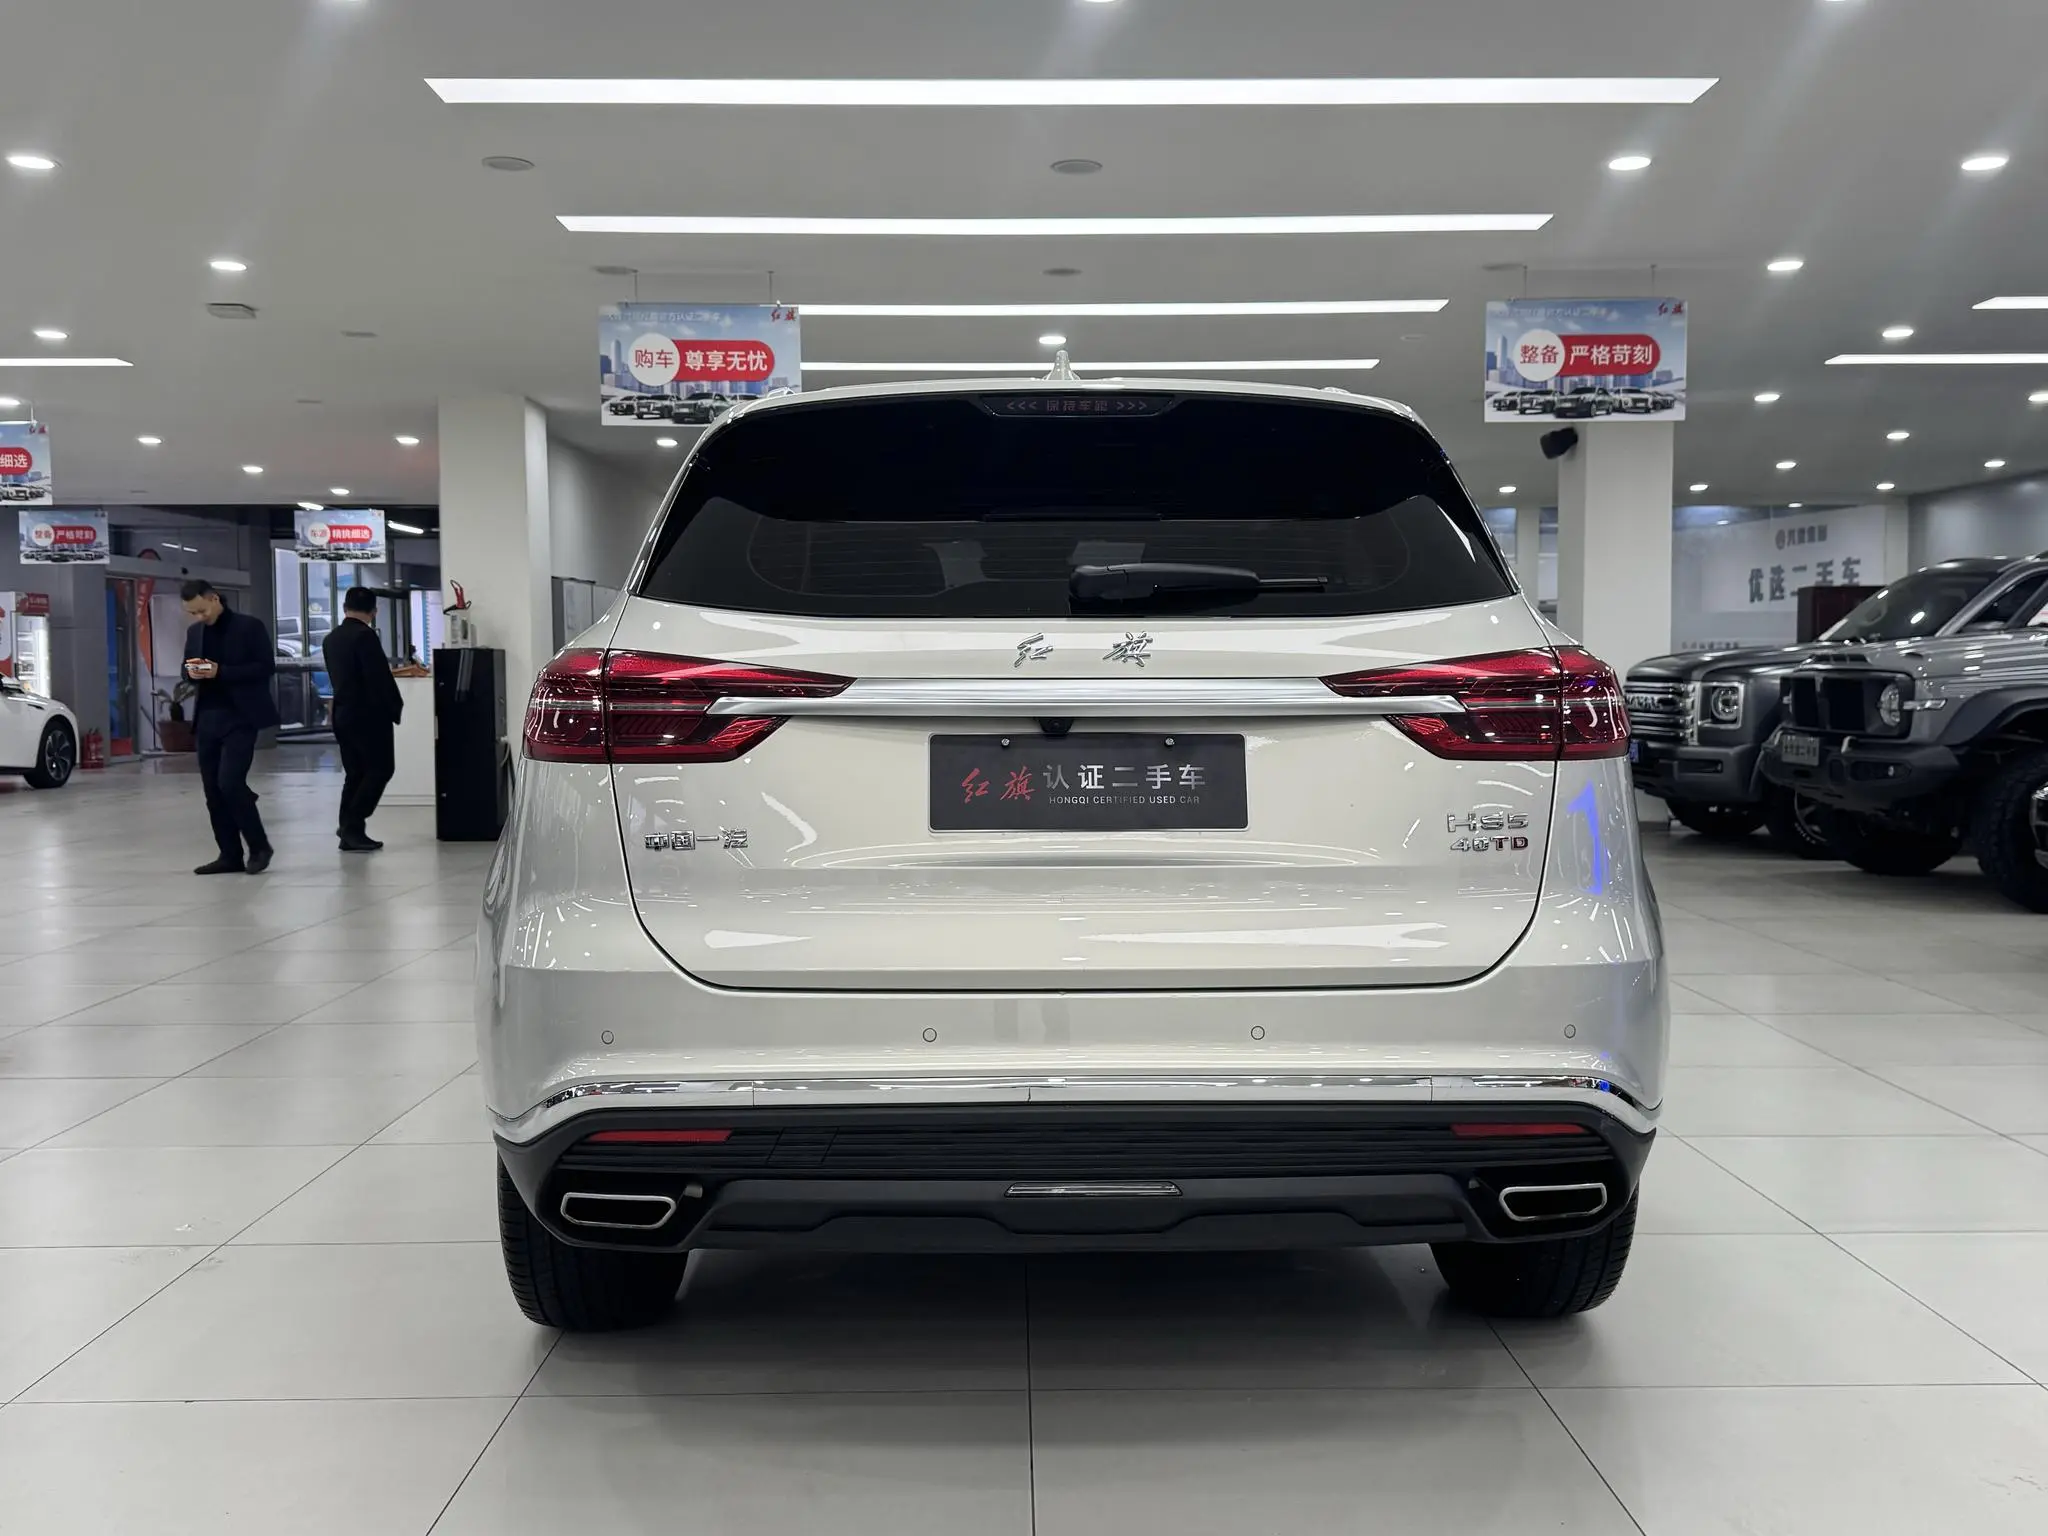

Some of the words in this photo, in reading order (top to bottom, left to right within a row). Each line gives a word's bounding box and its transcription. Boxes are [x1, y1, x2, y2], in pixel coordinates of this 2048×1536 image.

[634, 349, 674, 369] 购车
[685, 350, 768, 372] 尊享无忧
[1520, 344, 1559, 365] 整备
[1569, 344, 1653, 366] 严格苛刻
[1043, 764, 1206, 790] 认证二手车
[1049, 795, 1090, 805] HONGQI
[1093, 795, 1145, 805] CERTIFIED
[1149, 795, 1176, 805] USED
[1180, 795, 1200, 805] CAR
[1447, 811, 1529, 832] HS5
[644, 829, 748, 851] 中国一汽
[1450, 836, 1529, 852] 40TD
